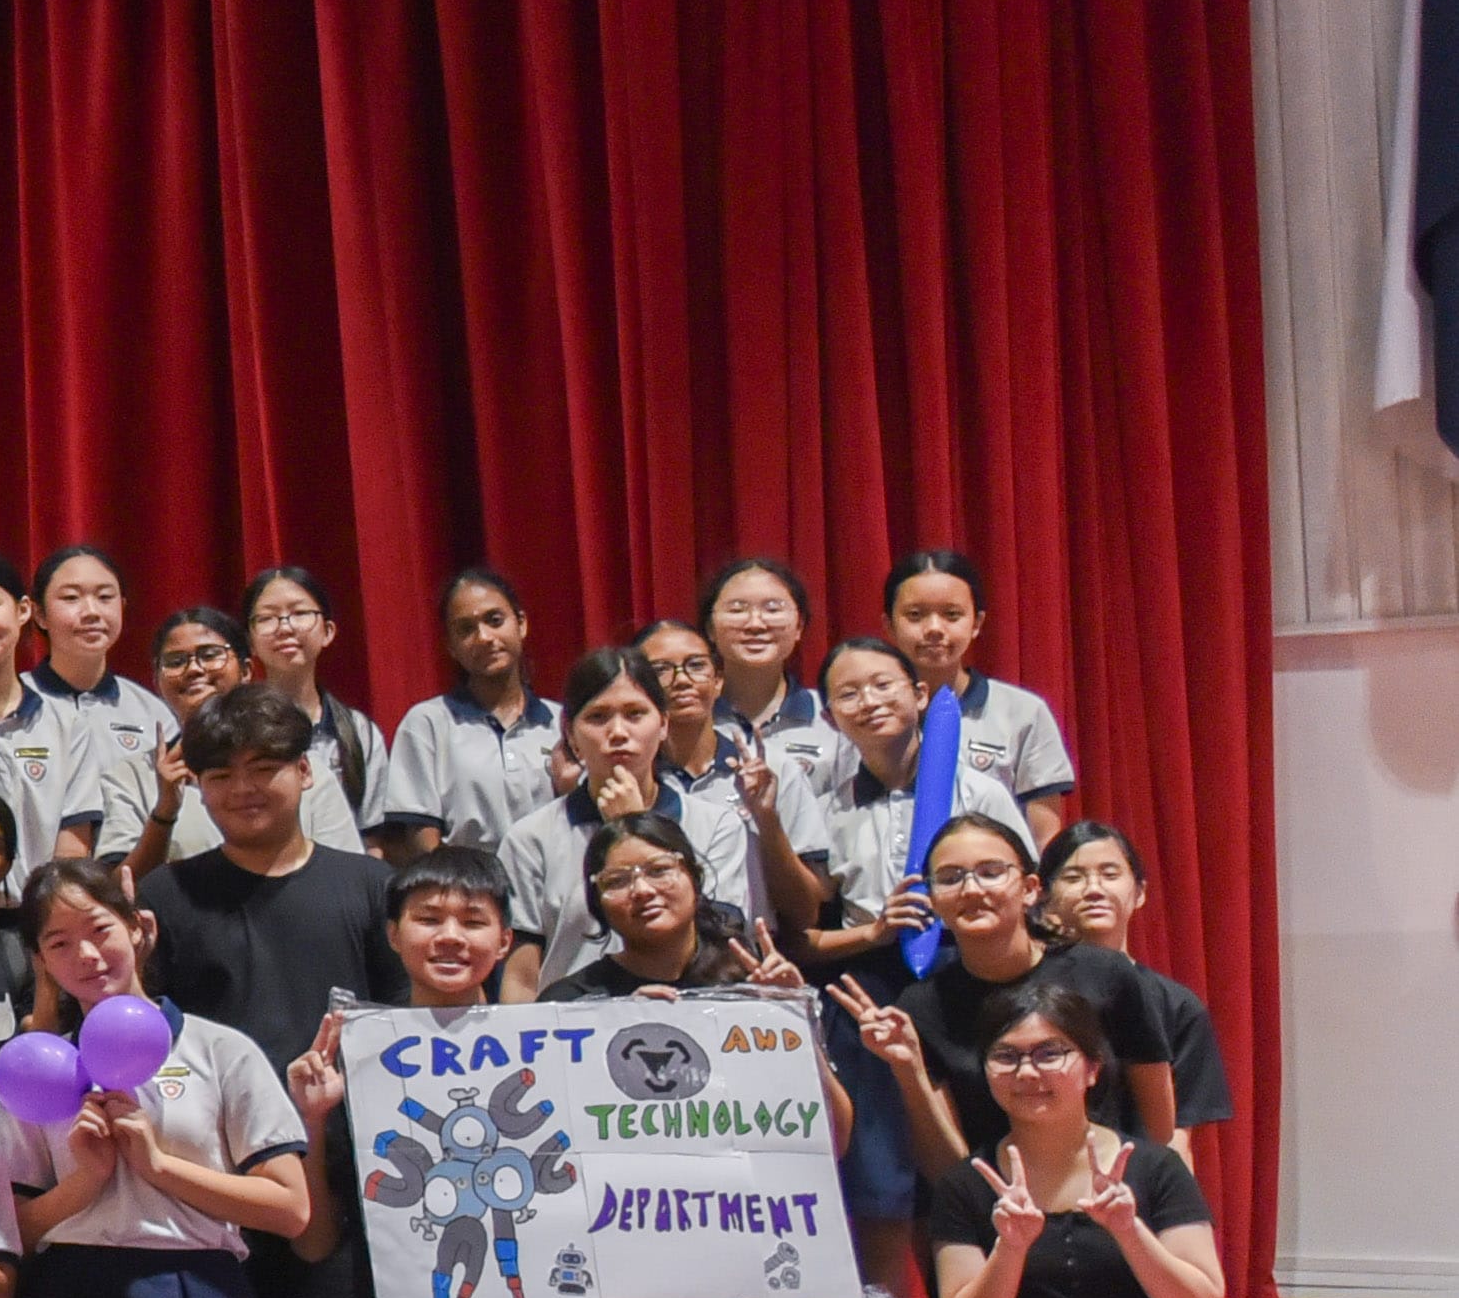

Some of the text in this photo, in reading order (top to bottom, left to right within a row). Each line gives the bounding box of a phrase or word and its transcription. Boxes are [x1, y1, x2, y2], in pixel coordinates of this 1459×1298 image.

[380, 1024, 803, 1079] CRAFT AND
[584, 1099, 821, 1141] TECHNOLOGY
[588, 1182, 820, 1238] DEPARTMENT
